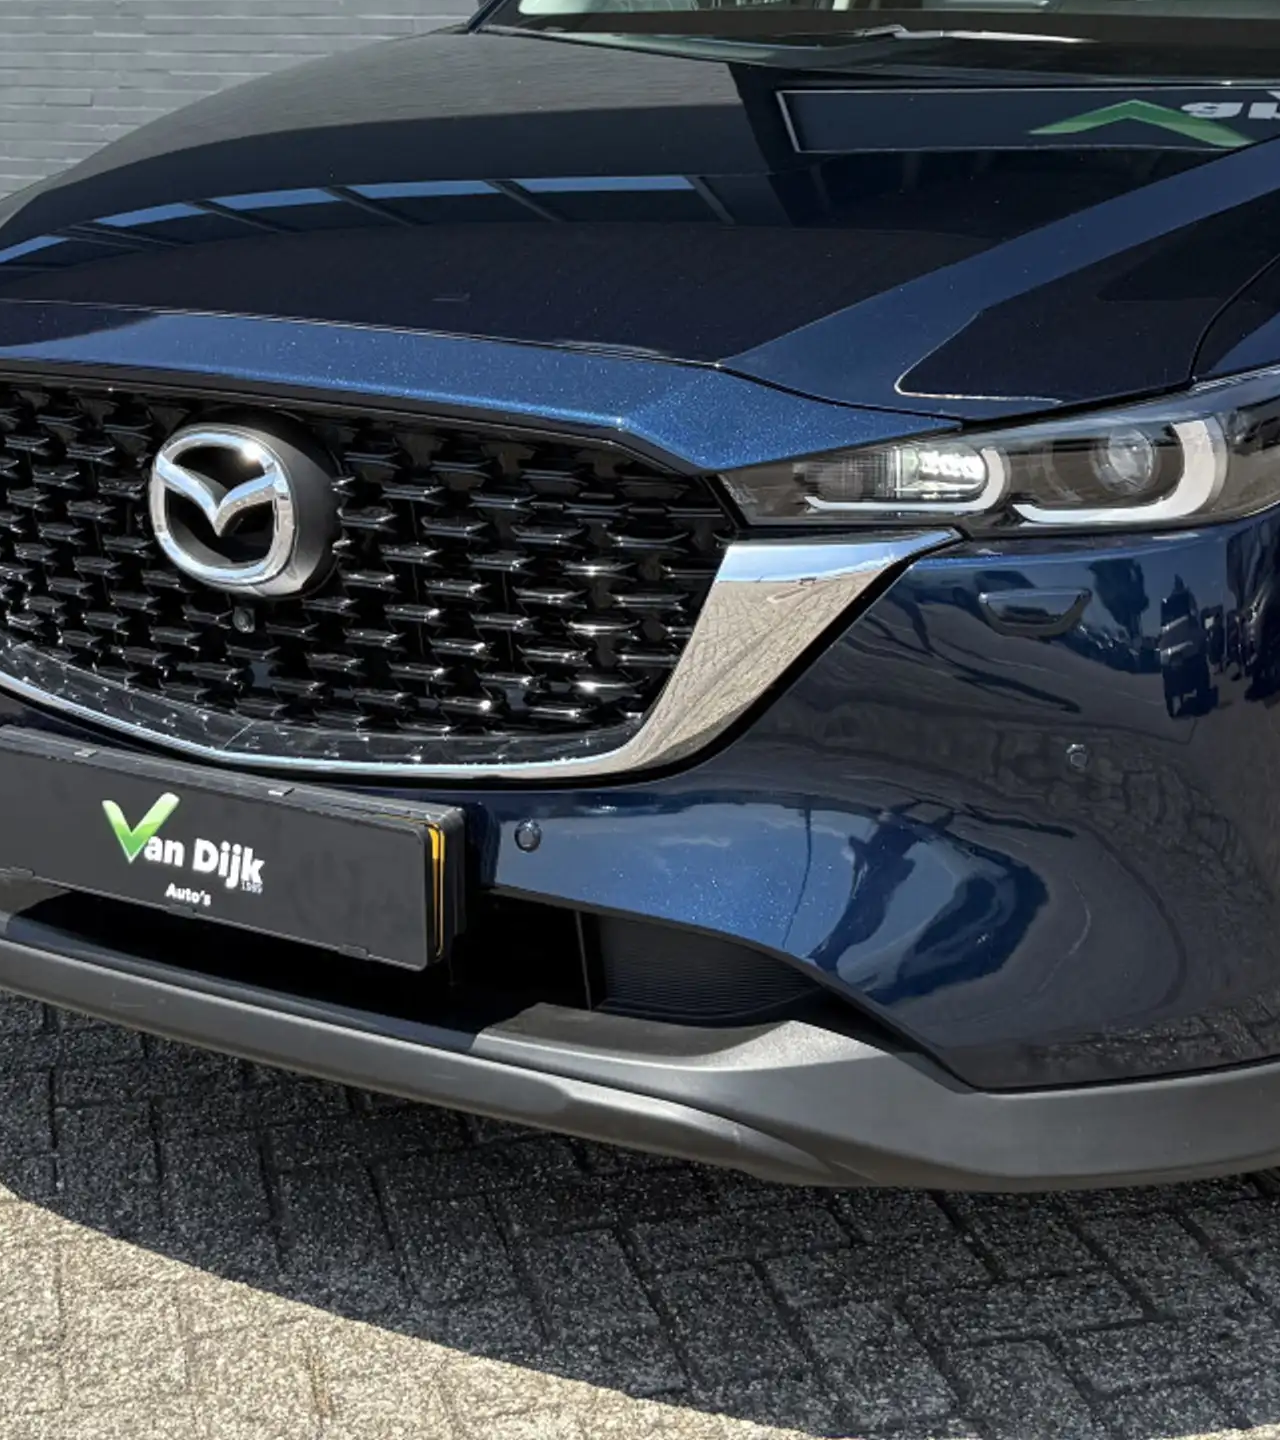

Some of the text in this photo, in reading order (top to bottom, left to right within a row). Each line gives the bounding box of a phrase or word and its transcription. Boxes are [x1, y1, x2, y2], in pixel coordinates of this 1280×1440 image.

[102, 792, 265, 890] Van Dijk
[164, 882, 212, 906] Auto's
